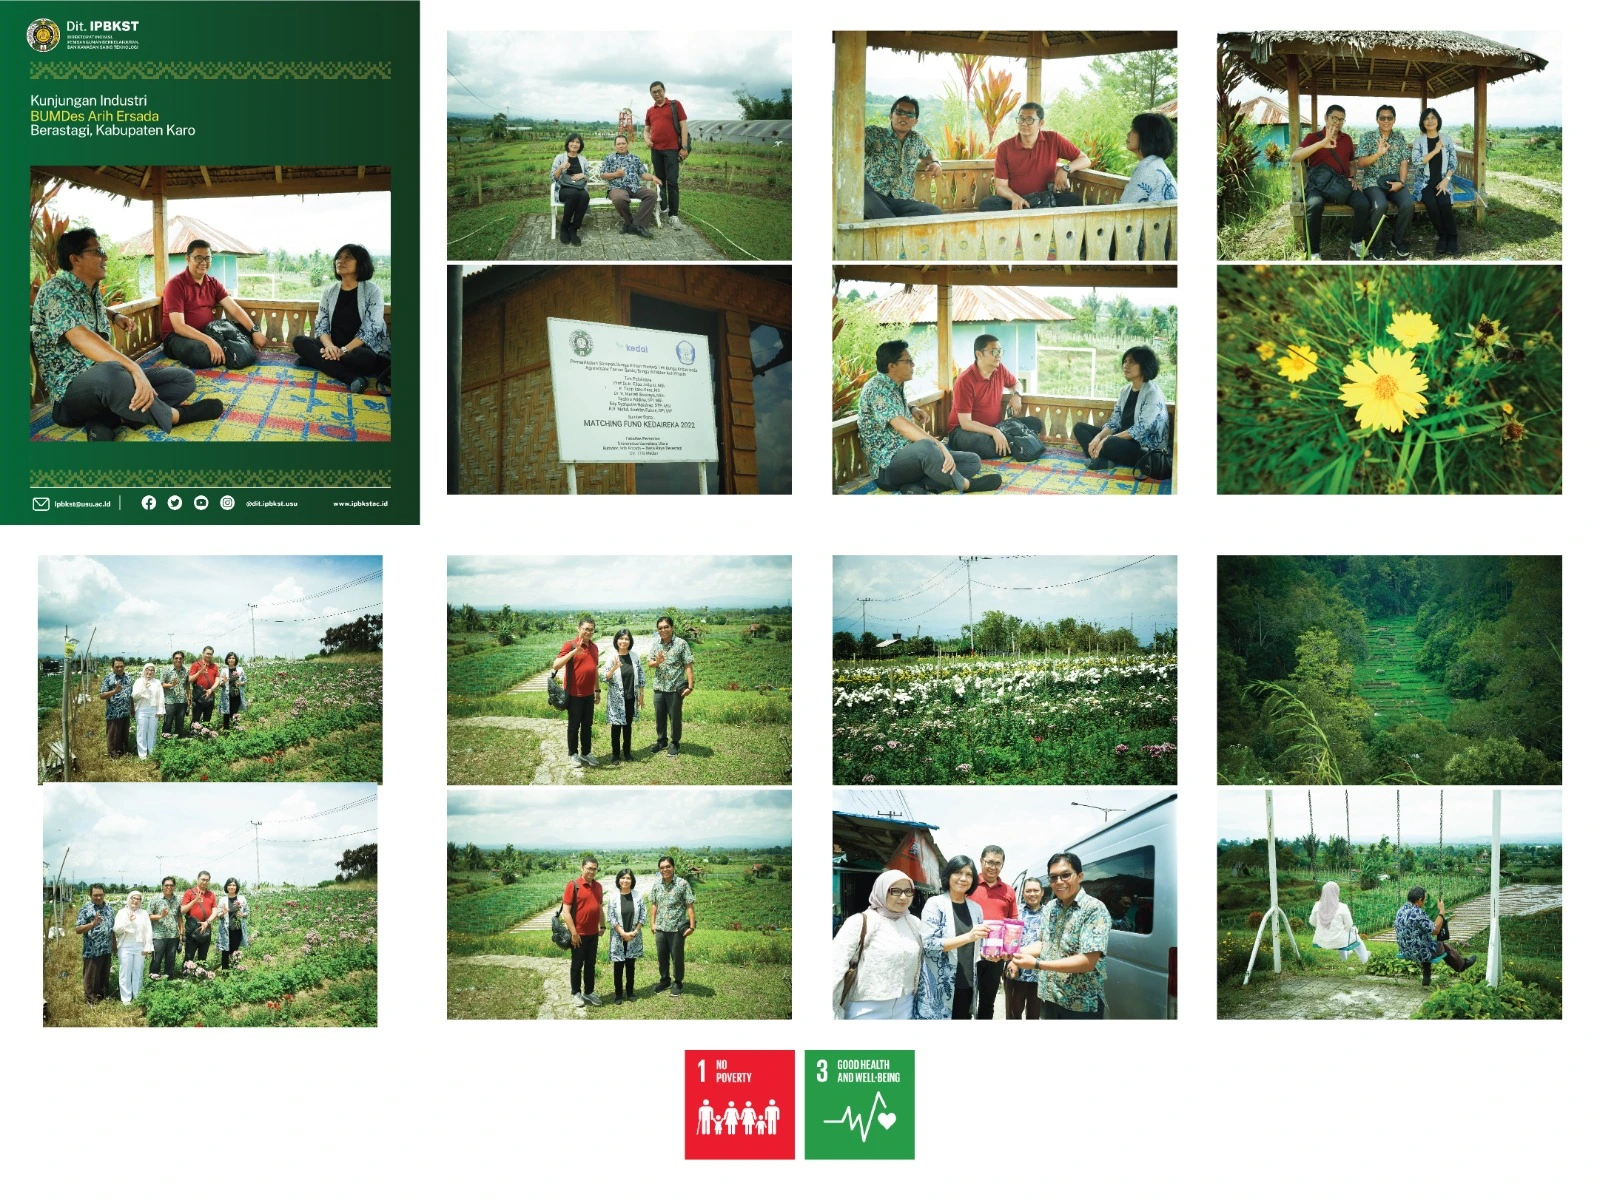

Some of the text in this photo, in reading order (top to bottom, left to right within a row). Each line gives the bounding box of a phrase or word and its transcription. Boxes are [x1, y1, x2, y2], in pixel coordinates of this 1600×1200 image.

[66, 20, 140, 32] Dit. IPBKST
[30, 94, 148, 108] Kunjungan Industri
[30, 110, 160, 122] BUMDes Arih Ersada
[30, 124, 196, 138] Berastagi, Kabupaten Karo
[583, 419, 696, 429] MATCHING FUND KEDAIREKA 2022
[715, 1059, 728, 1070] NO
[837, 1059, 890, 1070] GOOD HEALTH
[697, 1059, 706, 1083] 1
[816, 1059, 829, 1083] 3
[715, 1072, 752, 1083] POVERTY
[837, 1072, 901, 1083] AND WELL-BEING
